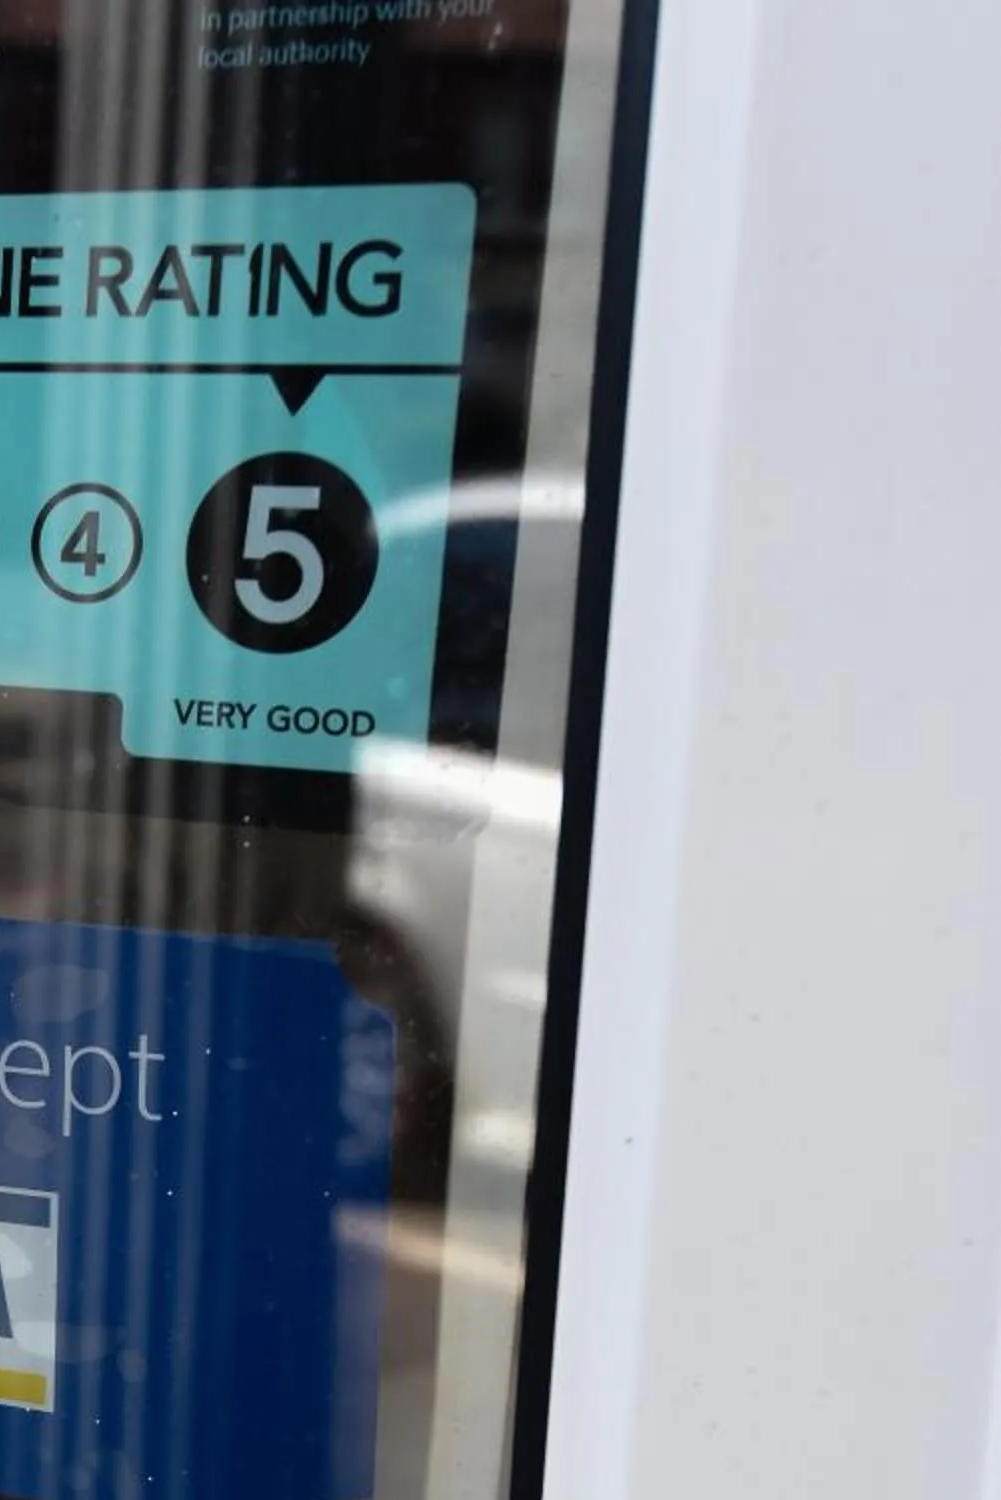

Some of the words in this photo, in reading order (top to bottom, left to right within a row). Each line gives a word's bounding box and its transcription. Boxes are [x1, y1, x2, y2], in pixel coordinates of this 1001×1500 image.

[228, 0, 369, 38] partnership
[375, 0, 431, 22] with
[197, 41, 253, 69] local
[259, 37, 372, 67] authority
[84, 239, 404, 319] RATING
[59, 510, 106, 577] 4
[234, 485, 325, 625] 5
[173, 697, 257, 730] VERY
[266, 704, 376, 738] GOOD
